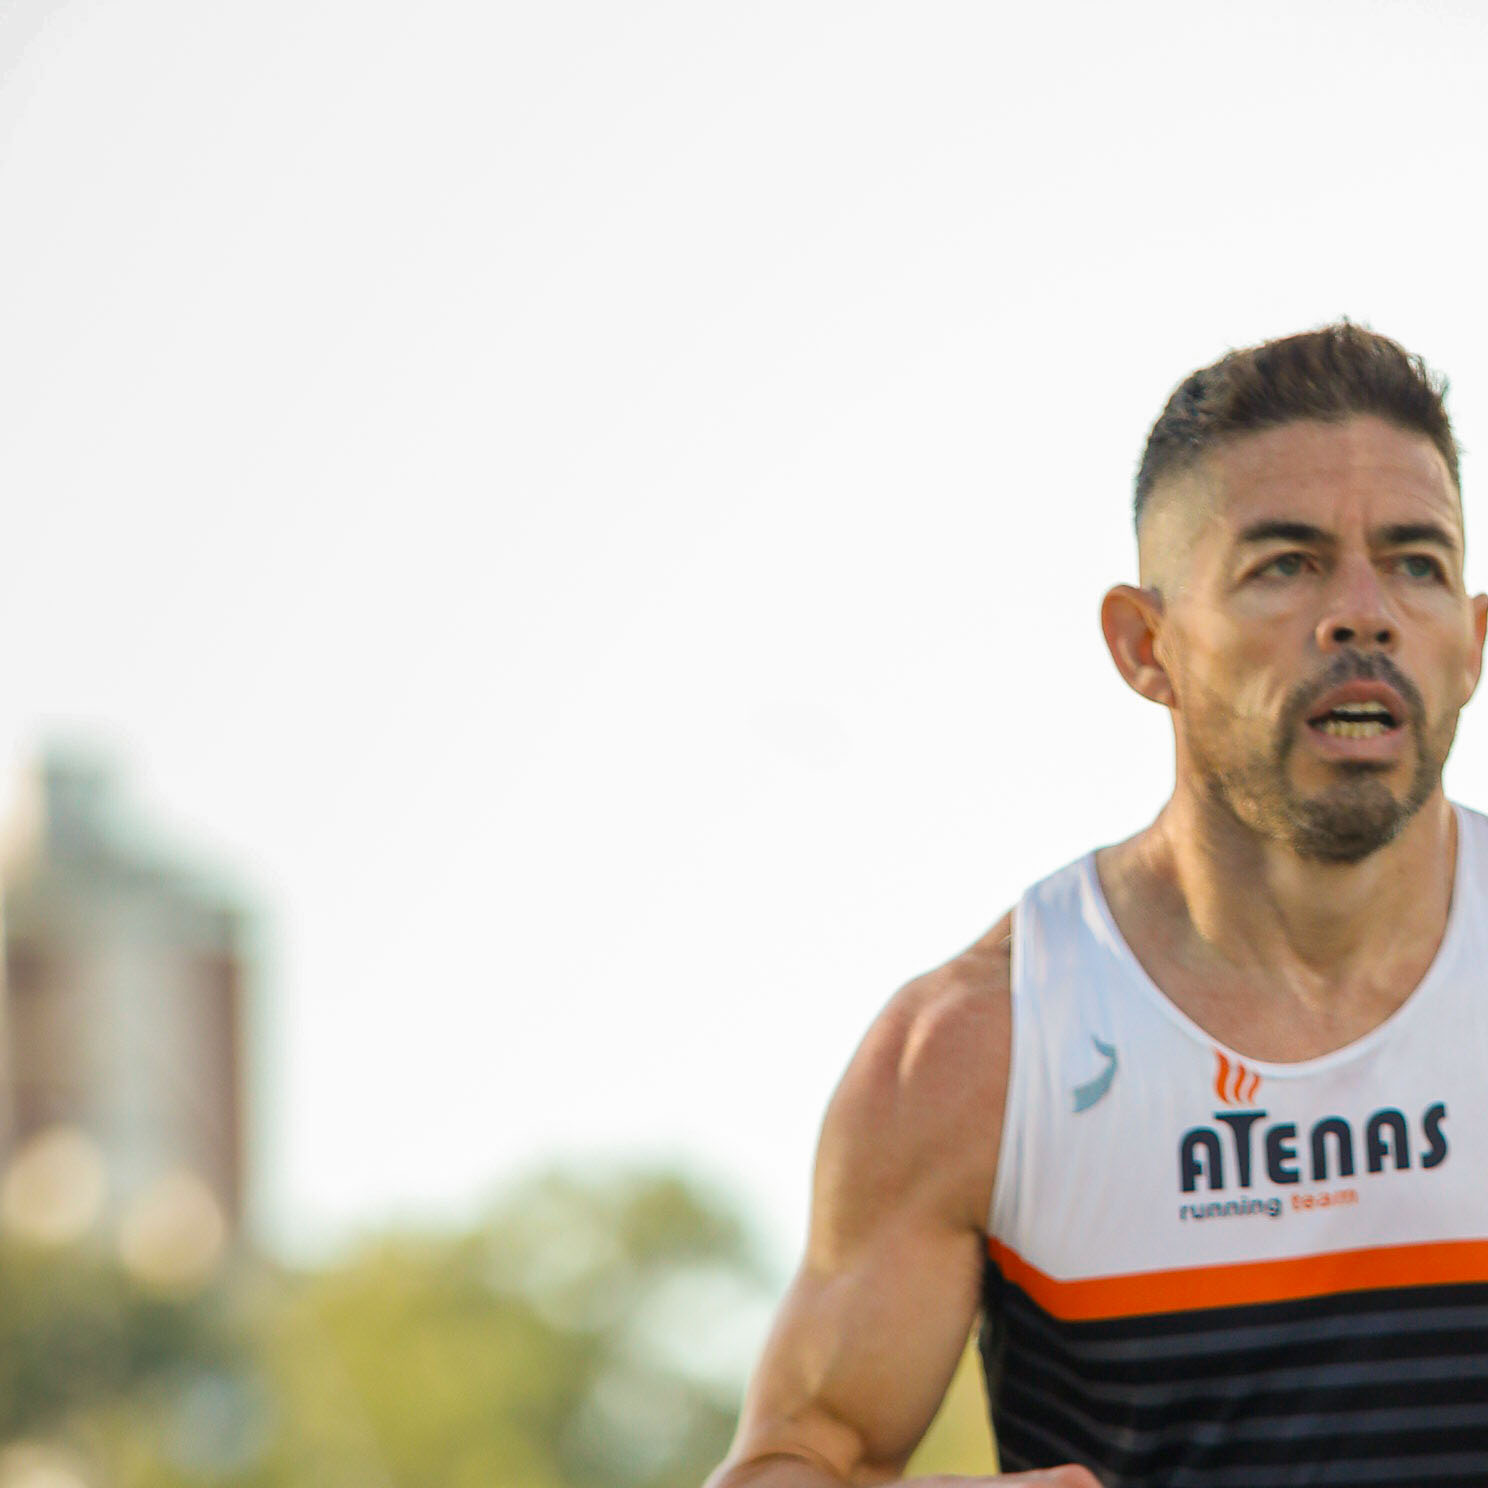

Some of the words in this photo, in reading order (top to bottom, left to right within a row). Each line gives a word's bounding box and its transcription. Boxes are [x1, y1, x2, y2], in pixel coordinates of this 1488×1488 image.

[1180, 1102, 1448, 1193] ATENAS
[1179, 1195, 1282, 1220] running
[1291, 1189, 1359, 1211] team
